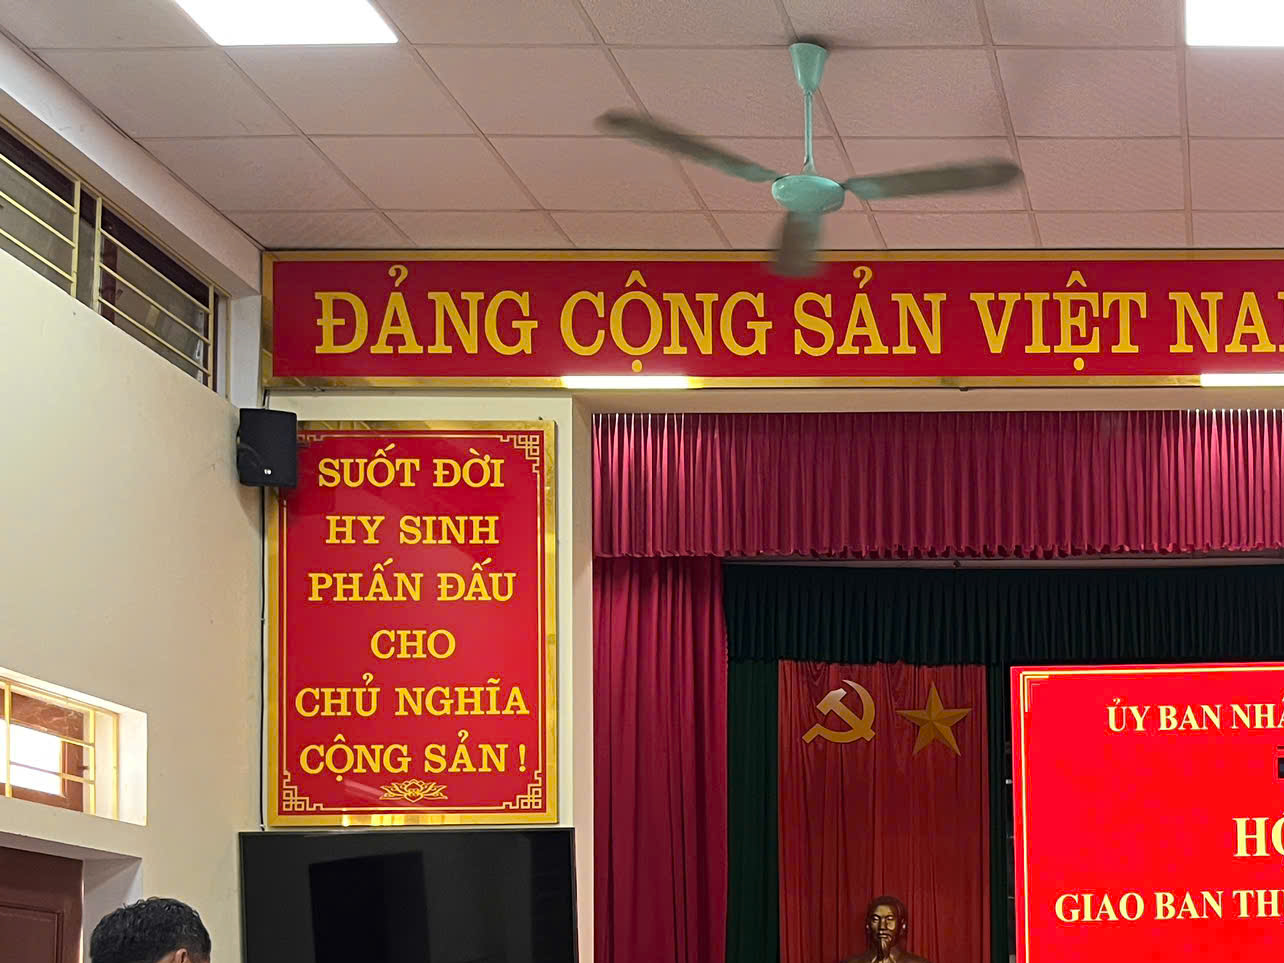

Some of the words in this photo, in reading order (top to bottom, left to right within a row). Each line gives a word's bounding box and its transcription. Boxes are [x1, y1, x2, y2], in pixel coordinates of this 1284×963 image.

[315, 264, 538, 356] ĐẢNG
[560, 270, 773, 373] CỘNG
[794, 266, 946, 357] SẢN
[970, 270, 1147, 371] VIỆT
[318, 443, 420, 488] SUỐT
[432, 448, 505, 488] ĐỜI
[325, 515, 386, 545] HY
[399, 515, 500, 545] SINH
[308, 558, 425, 602] PHẤN
[436, 558, 517, 602] ĐẤU
[370, 628, 456, 660] CHO
[295, 672, 381, 717] CHỦ
[394, 677, 531, 716] NGHĨA
[1107, 698, 1151, 732] ỦY
[1158, 704, 1222, 731] BAN
[299, 733, 411, 783] CỘNG
[423, 729, 509, 774] SẢN
[518, 743, 527, 773] !
[1055, 892, 1145, 923] GIAO
[1154, 890, 1224, 920] BAN
